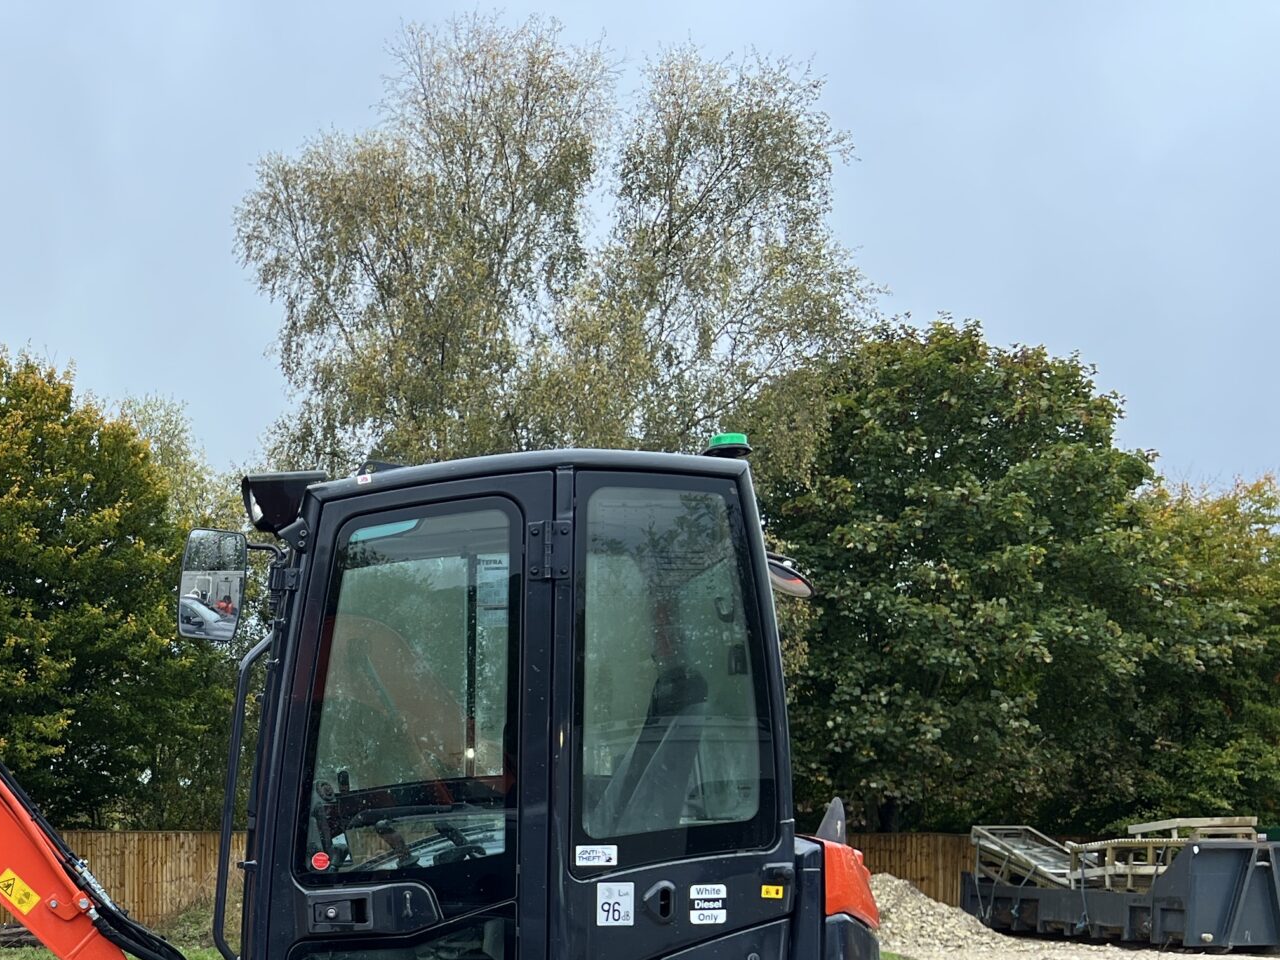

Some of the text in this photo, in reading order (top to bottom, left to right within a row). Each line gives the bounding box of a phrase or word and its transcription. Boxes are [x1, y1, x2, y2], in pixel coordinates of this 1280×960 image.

[695, 887, 721, 896] White
[694, 899, 723, 909] Diesel
[601, 901, 621, 921] 96
[697, 912, 719, 923] Only
